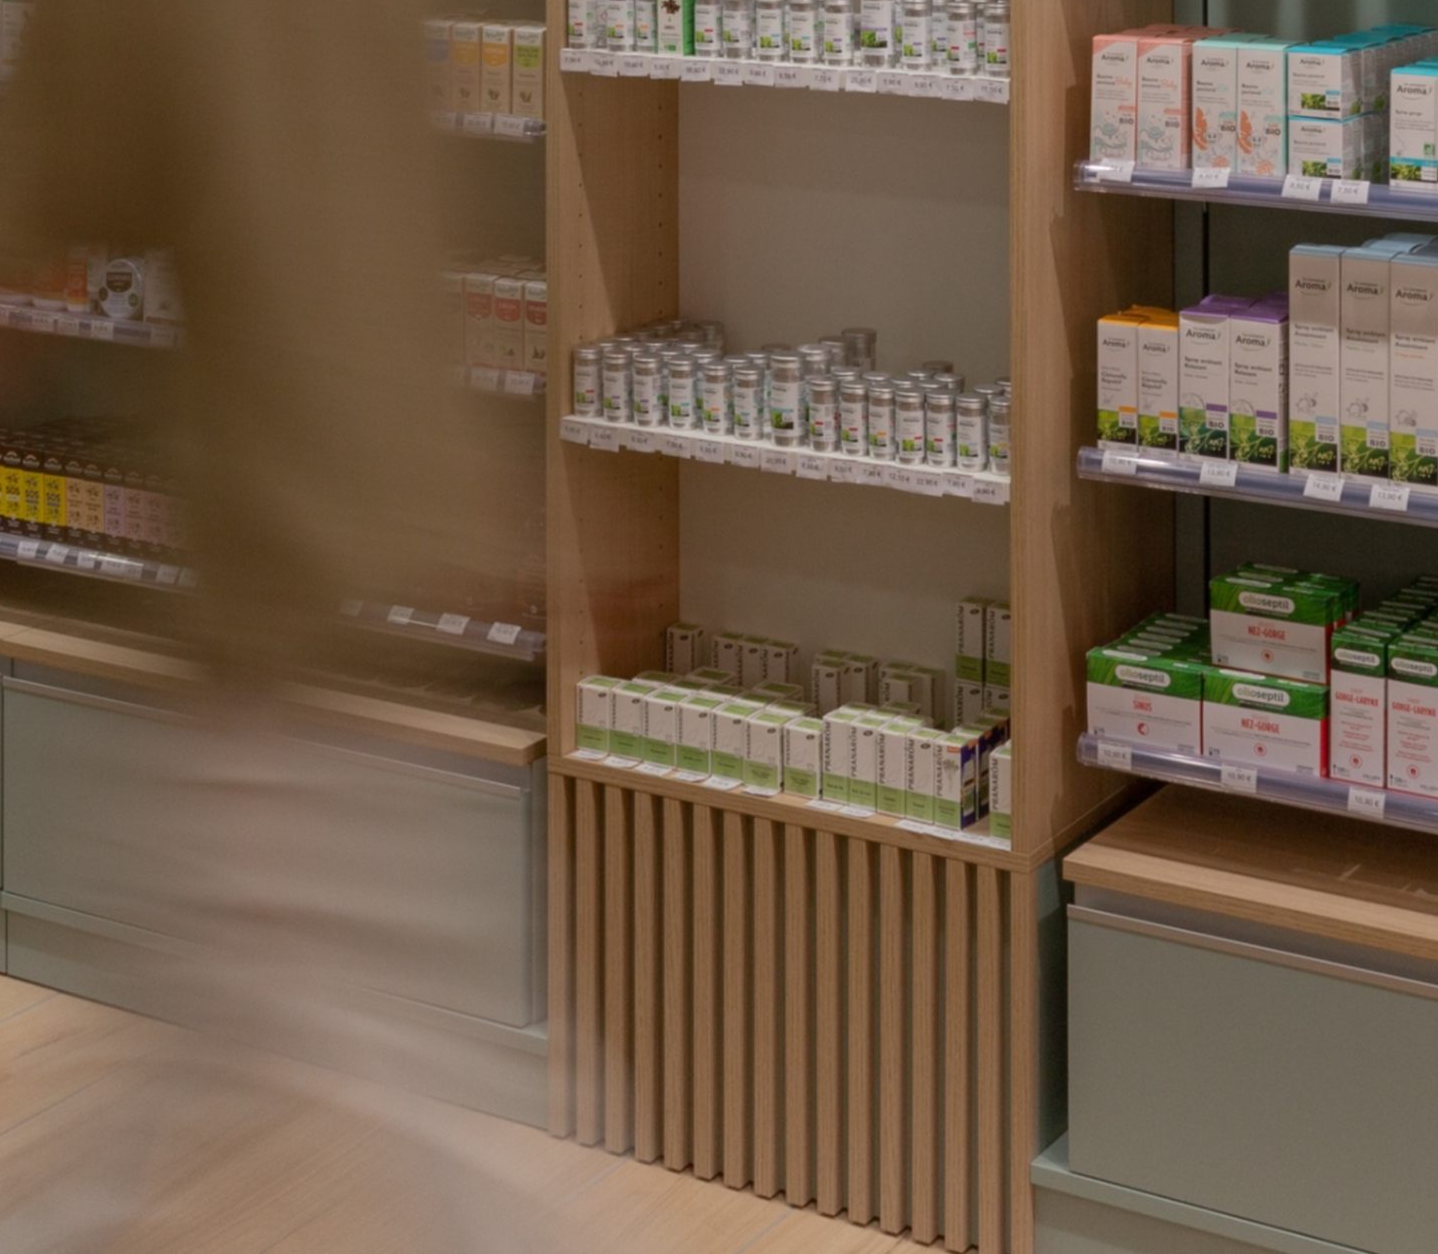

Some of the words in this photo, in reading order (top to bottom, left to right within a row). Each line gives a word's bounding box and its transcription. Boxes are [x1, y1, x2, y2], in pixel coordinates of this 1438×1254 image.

[1241, 591, 1292, 612] olioseptil
[1247, 624, 1286, 641] NEZ-GORGE
[1116, 666, 1168, 688] olioseptil
[1132, 697, 1153, 712] SINUS
[1234, 684, 1286, 706] olioseptil
[1240, 718, 1280, 735] NEZ-GORGE
